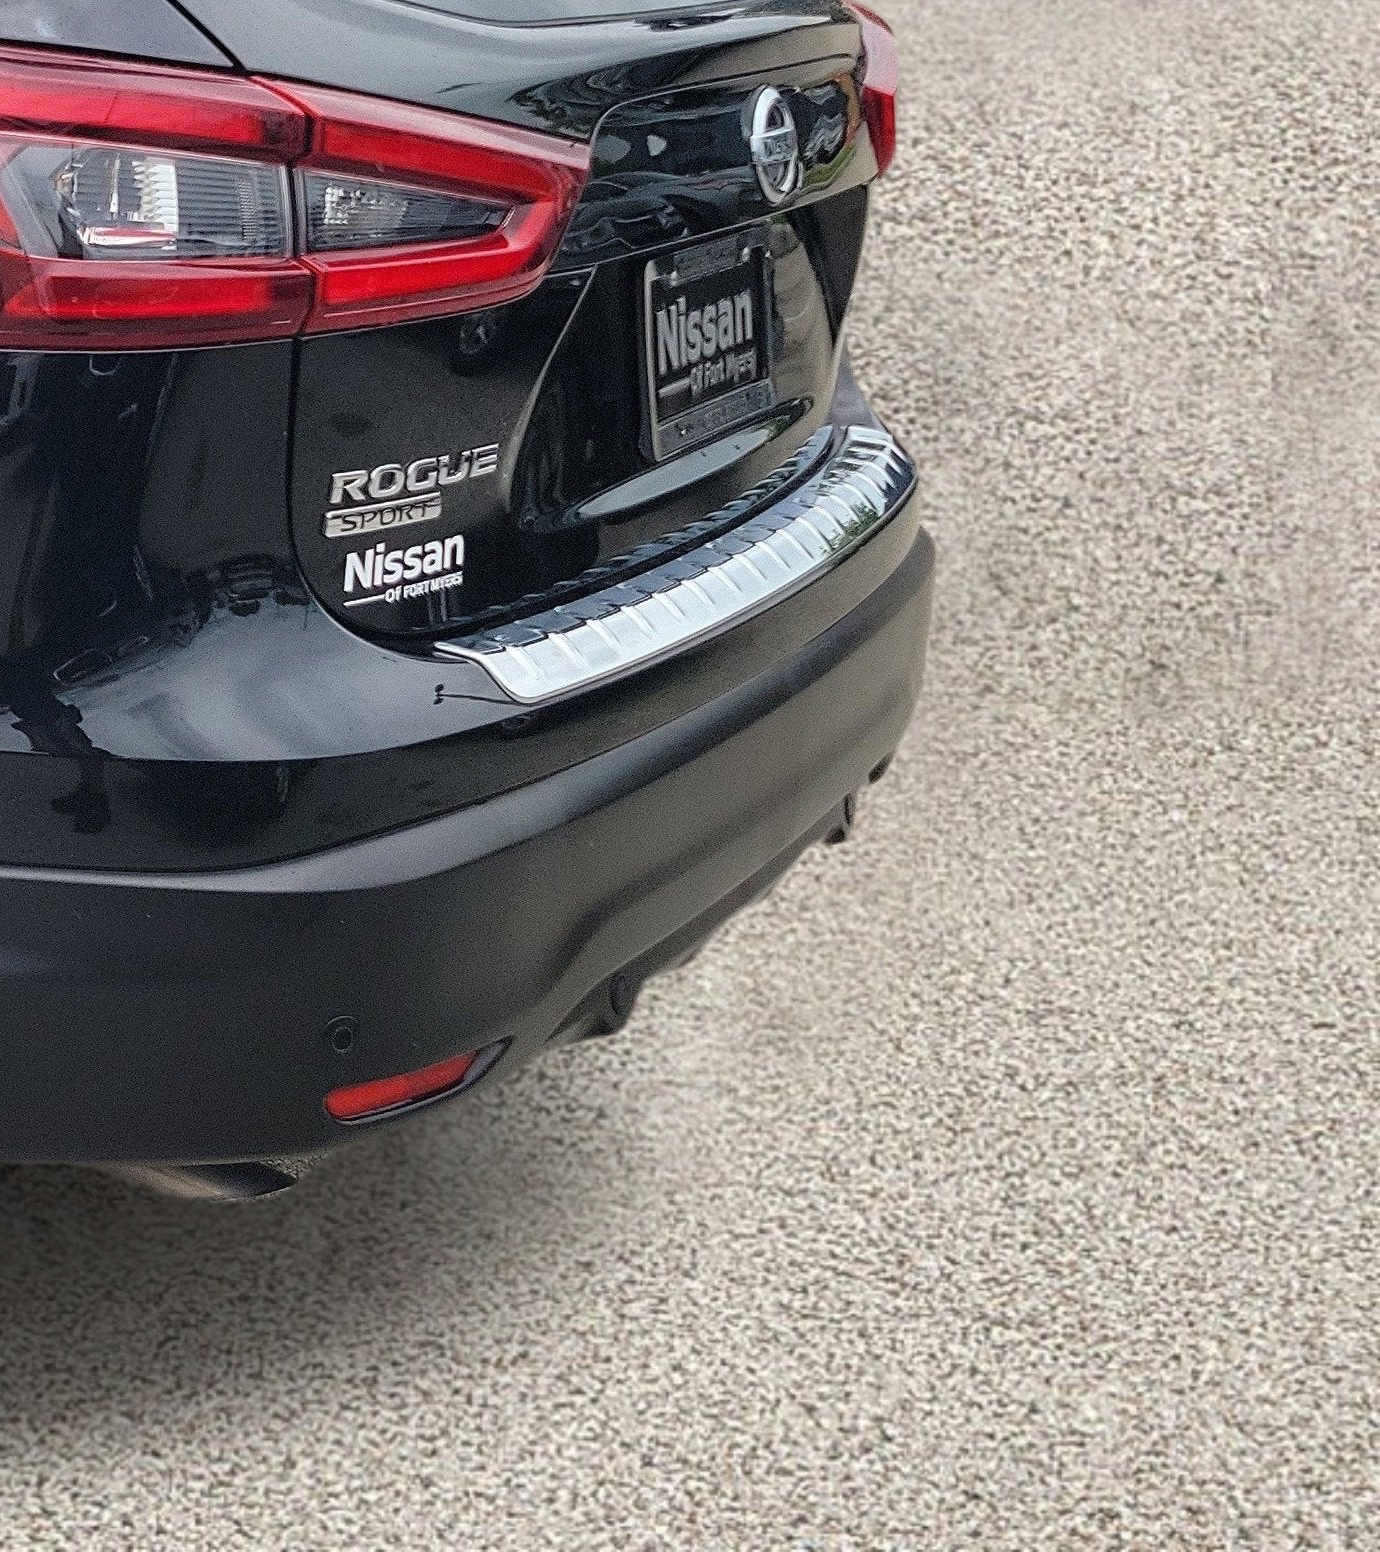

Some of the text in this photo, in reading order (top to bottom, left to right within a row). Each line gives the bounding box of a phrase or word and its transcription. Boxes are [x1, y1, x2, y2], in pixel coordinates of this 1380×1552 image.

[655, 289, 753, 376] Nissan
[329, 443, 500, 504] ROGUE
[340, 501, 439, 531] SPORT
[343, 534, 465, 593] Nissan
